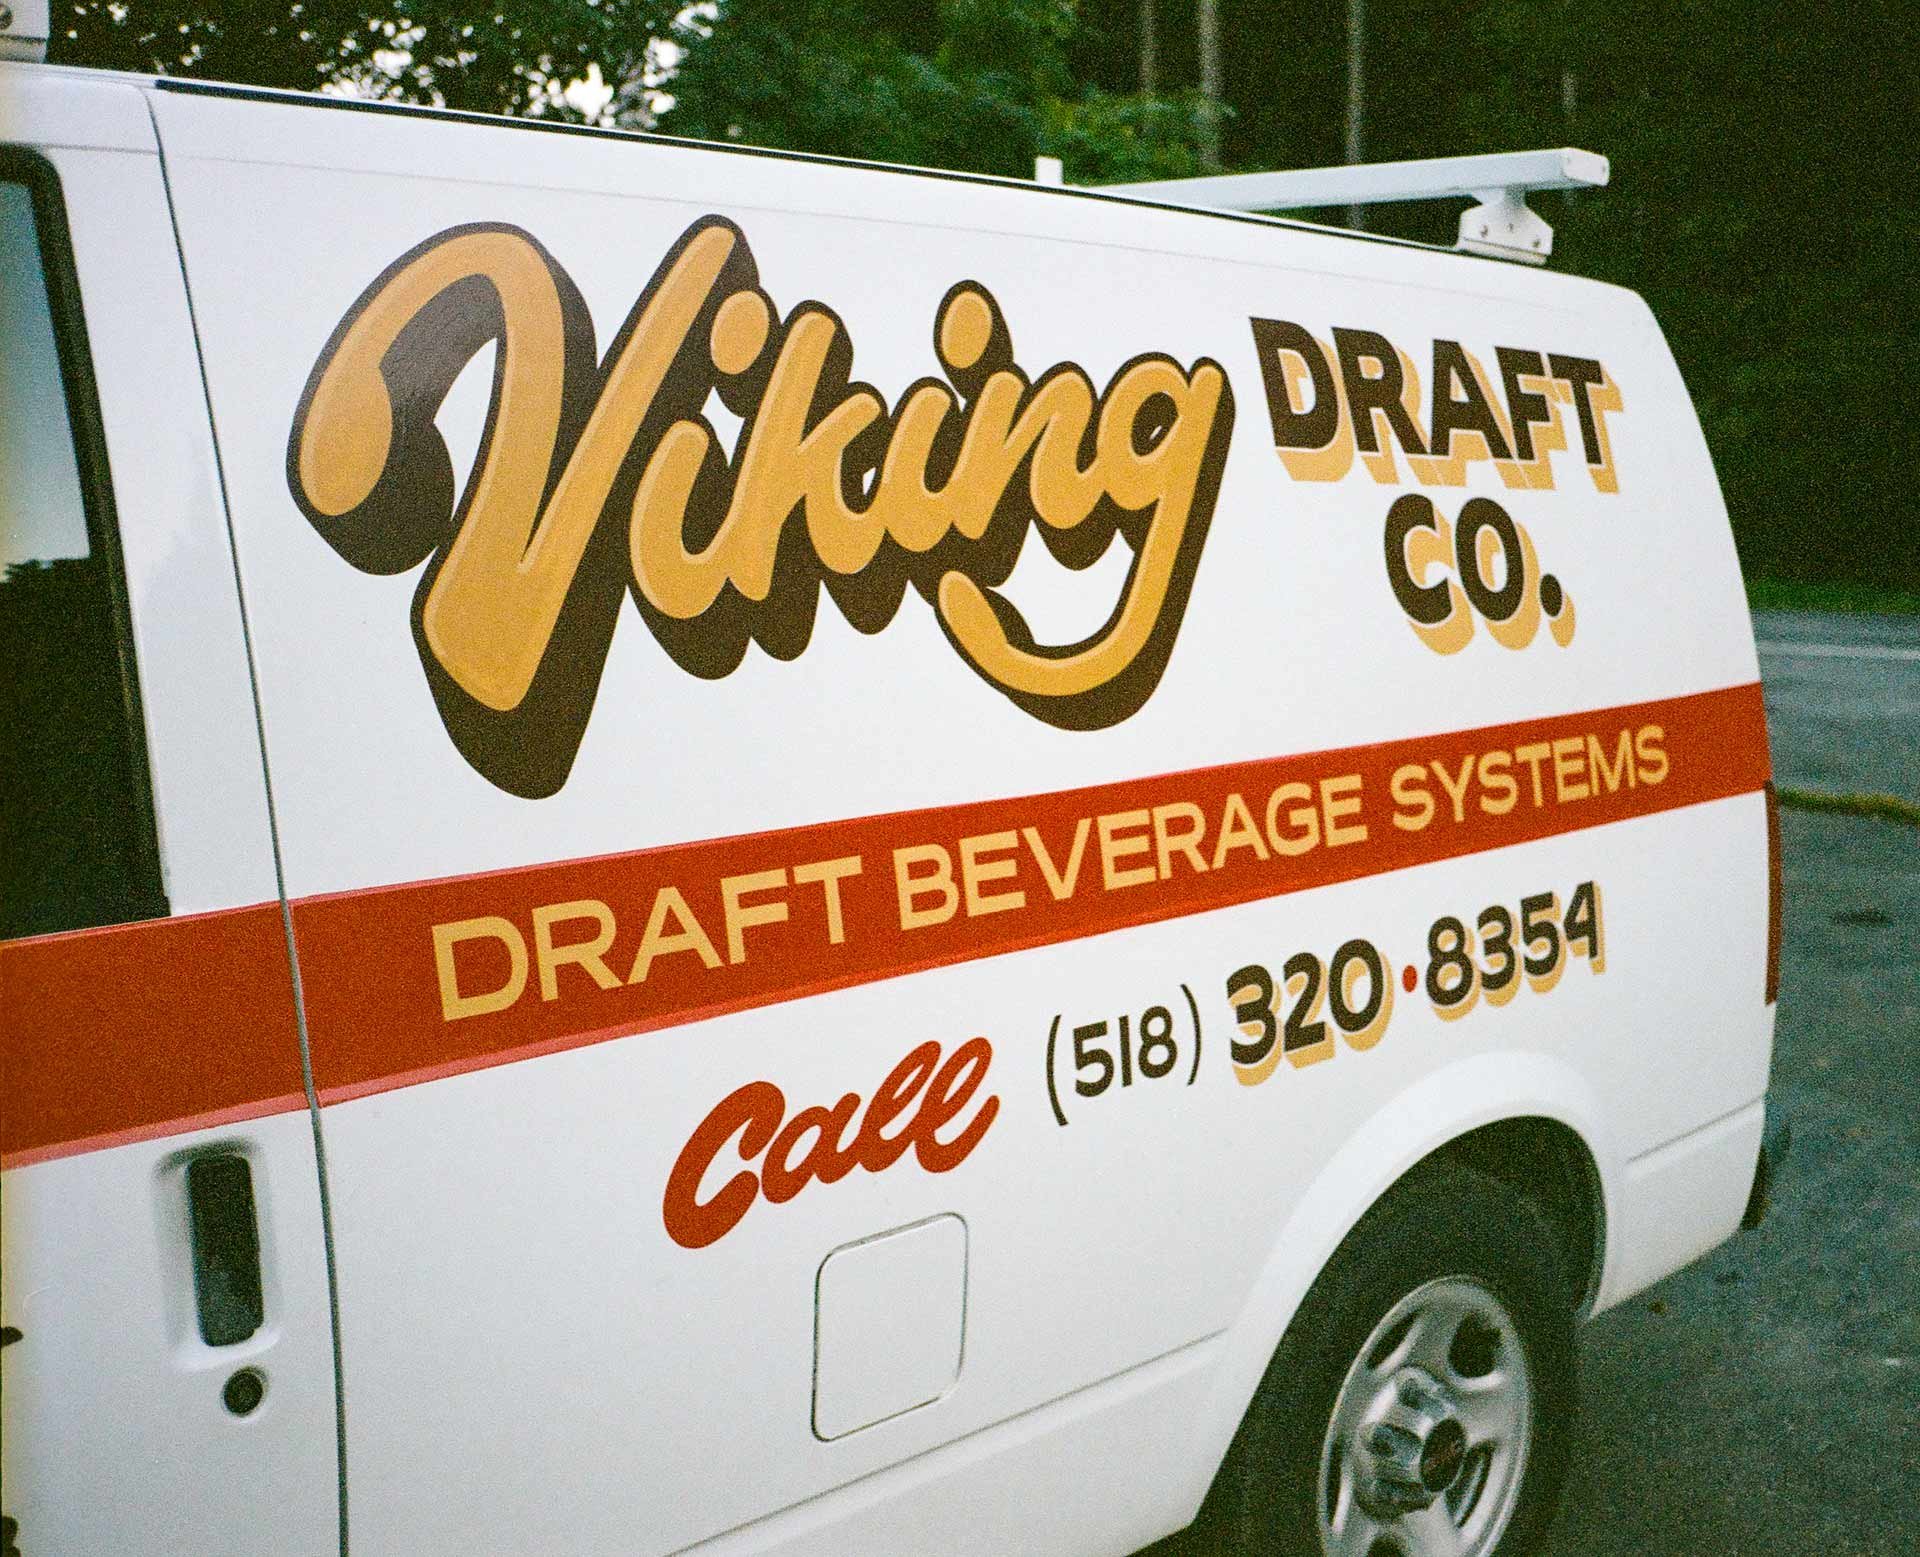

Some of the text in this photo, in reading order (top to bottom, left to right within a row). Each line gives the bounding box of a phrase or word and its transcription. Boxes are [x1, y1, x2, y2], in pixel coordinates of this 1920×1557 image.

[287, 214, 1236, 799] Viking
[1250, 317, 1624, 494] DRAFT
[1384, 493, 1576, 655] CO.
[432, 725, 1669, 1021] DRAFT BEVERAGE SYSTEMS
[662, 1036, 1000, 1249] Call
[1046, 984, 1201, 1126] (518)
